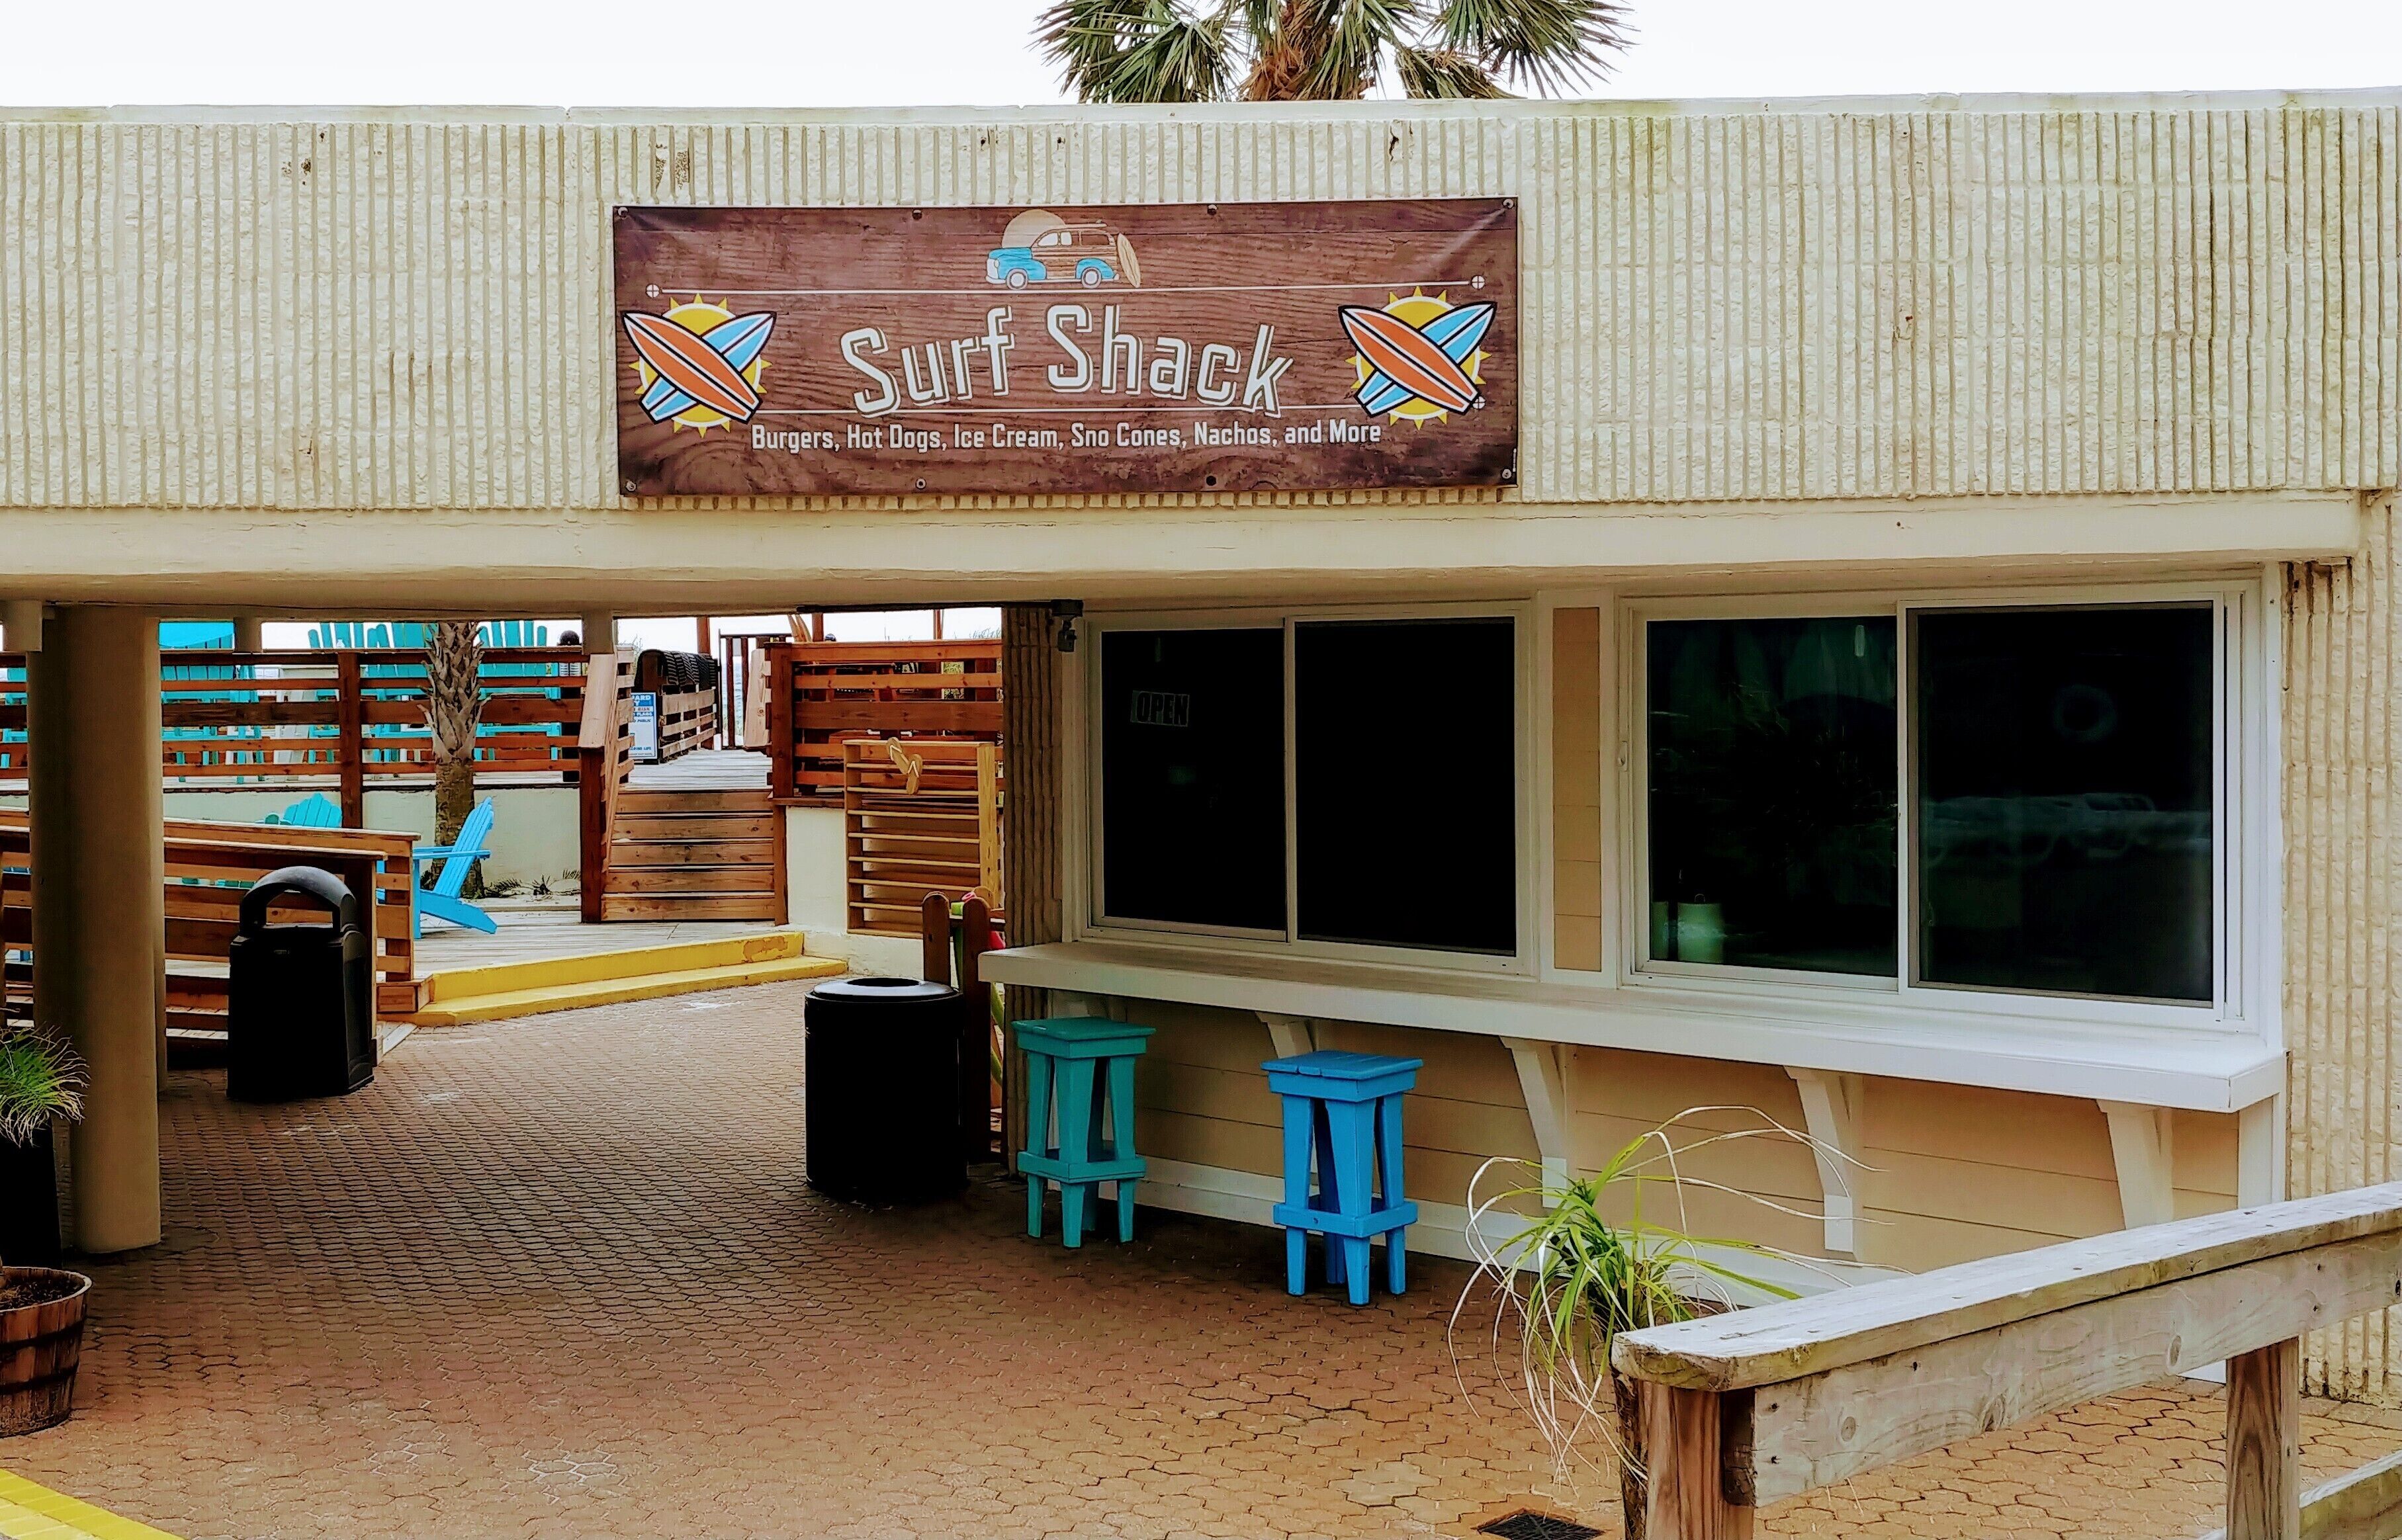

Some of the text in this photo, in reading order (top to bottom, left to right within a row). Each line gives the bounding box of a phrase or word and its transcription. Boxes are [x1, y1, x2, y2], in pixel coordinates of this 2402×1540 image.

[840, 304, 1293, 417] Surf Shack
[751, 419, 1381, 454] Burgers, Hot Dogs, Ice Cream, Sno Cones, Nachos, and More
[1135, 691, 1190, 726] OPEN
